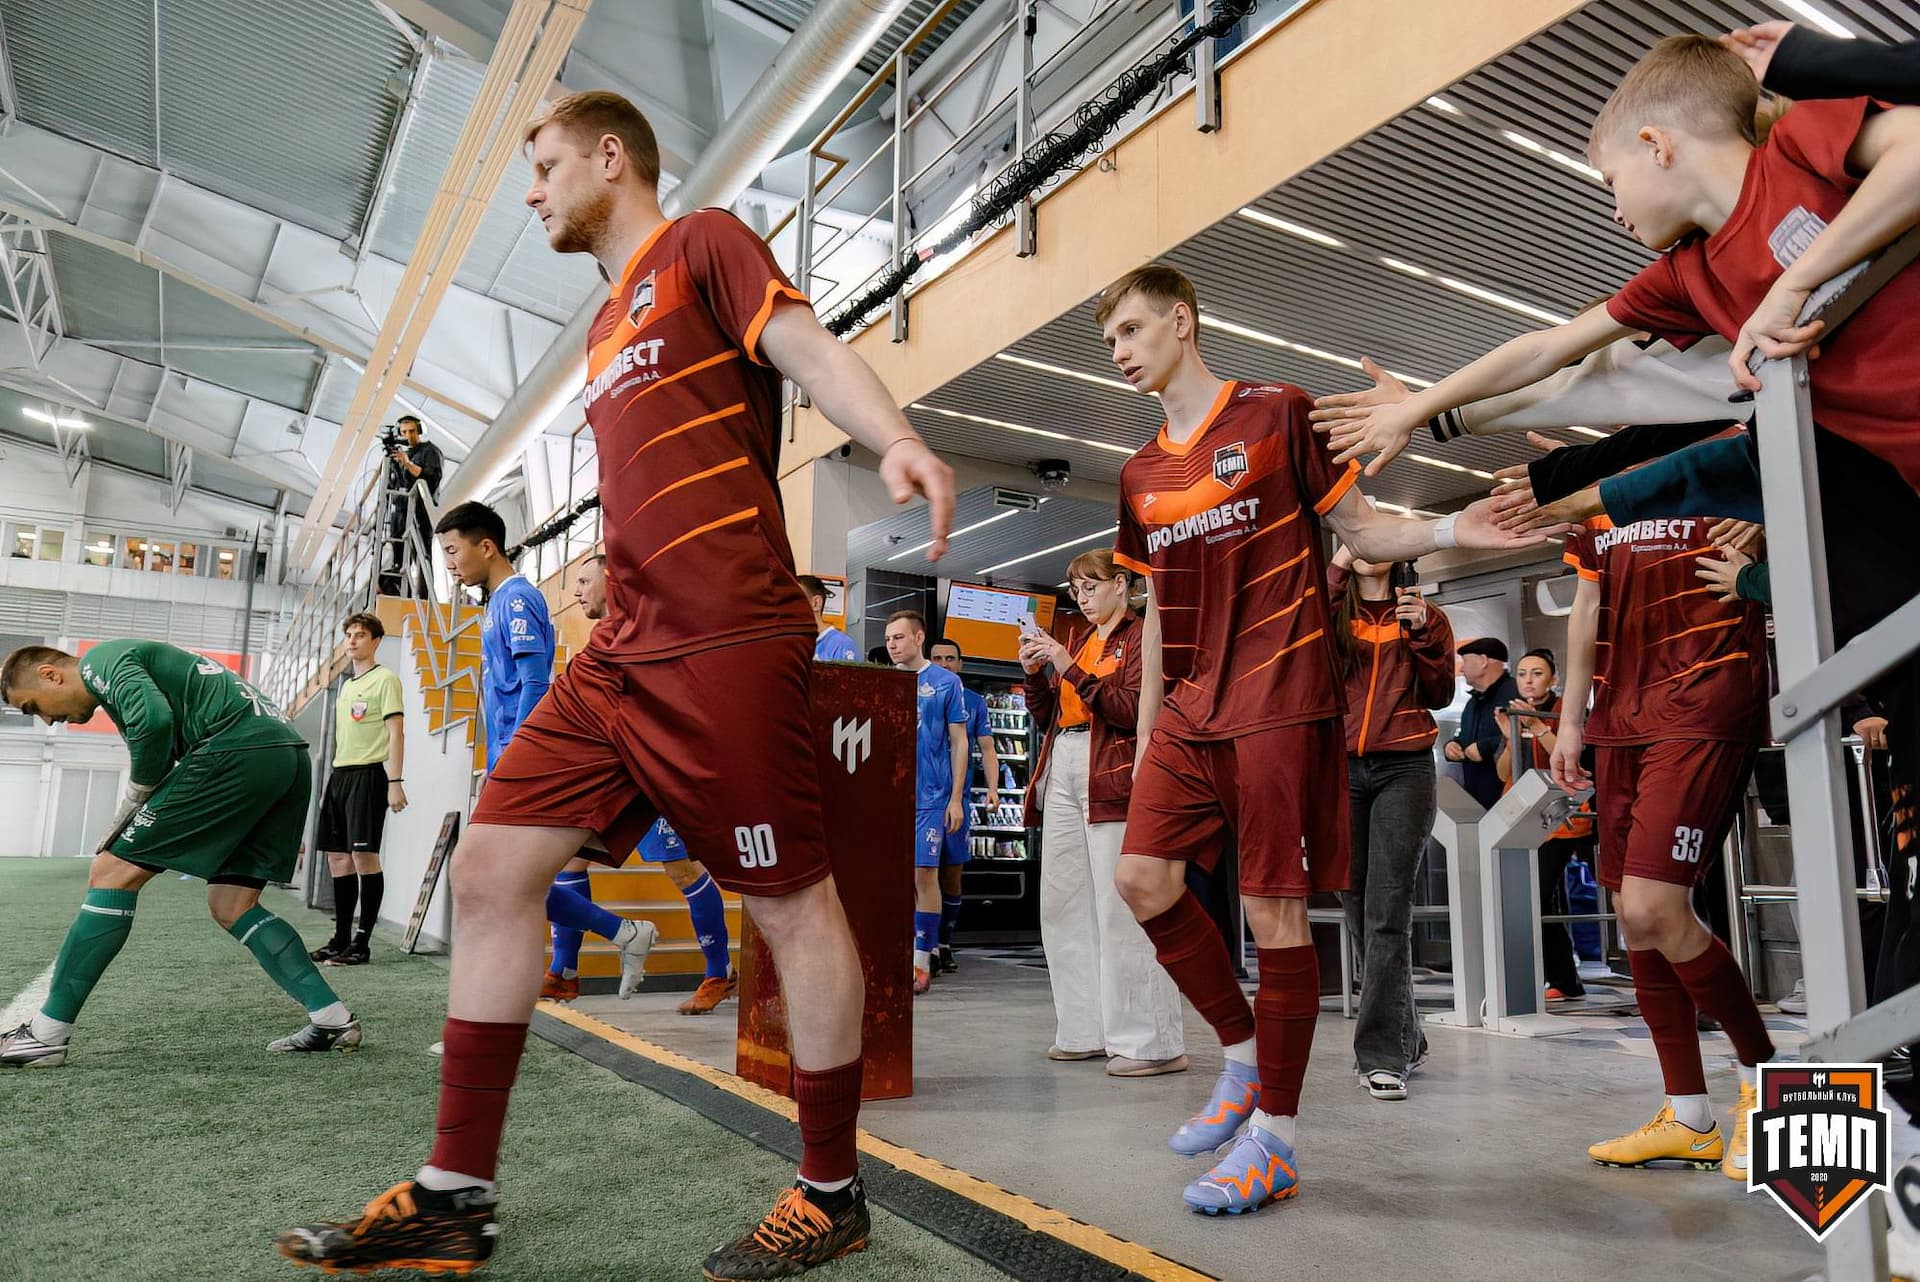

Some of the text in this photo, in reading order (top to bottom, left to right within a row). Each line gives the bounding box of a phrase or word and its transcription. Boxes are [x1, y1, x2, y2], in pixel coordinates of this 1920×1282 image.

[1216, 455, 1245, 476] ТЕМП
[734, 823, 777, 868] 90
[1671, 825, 1704, 863] 33
